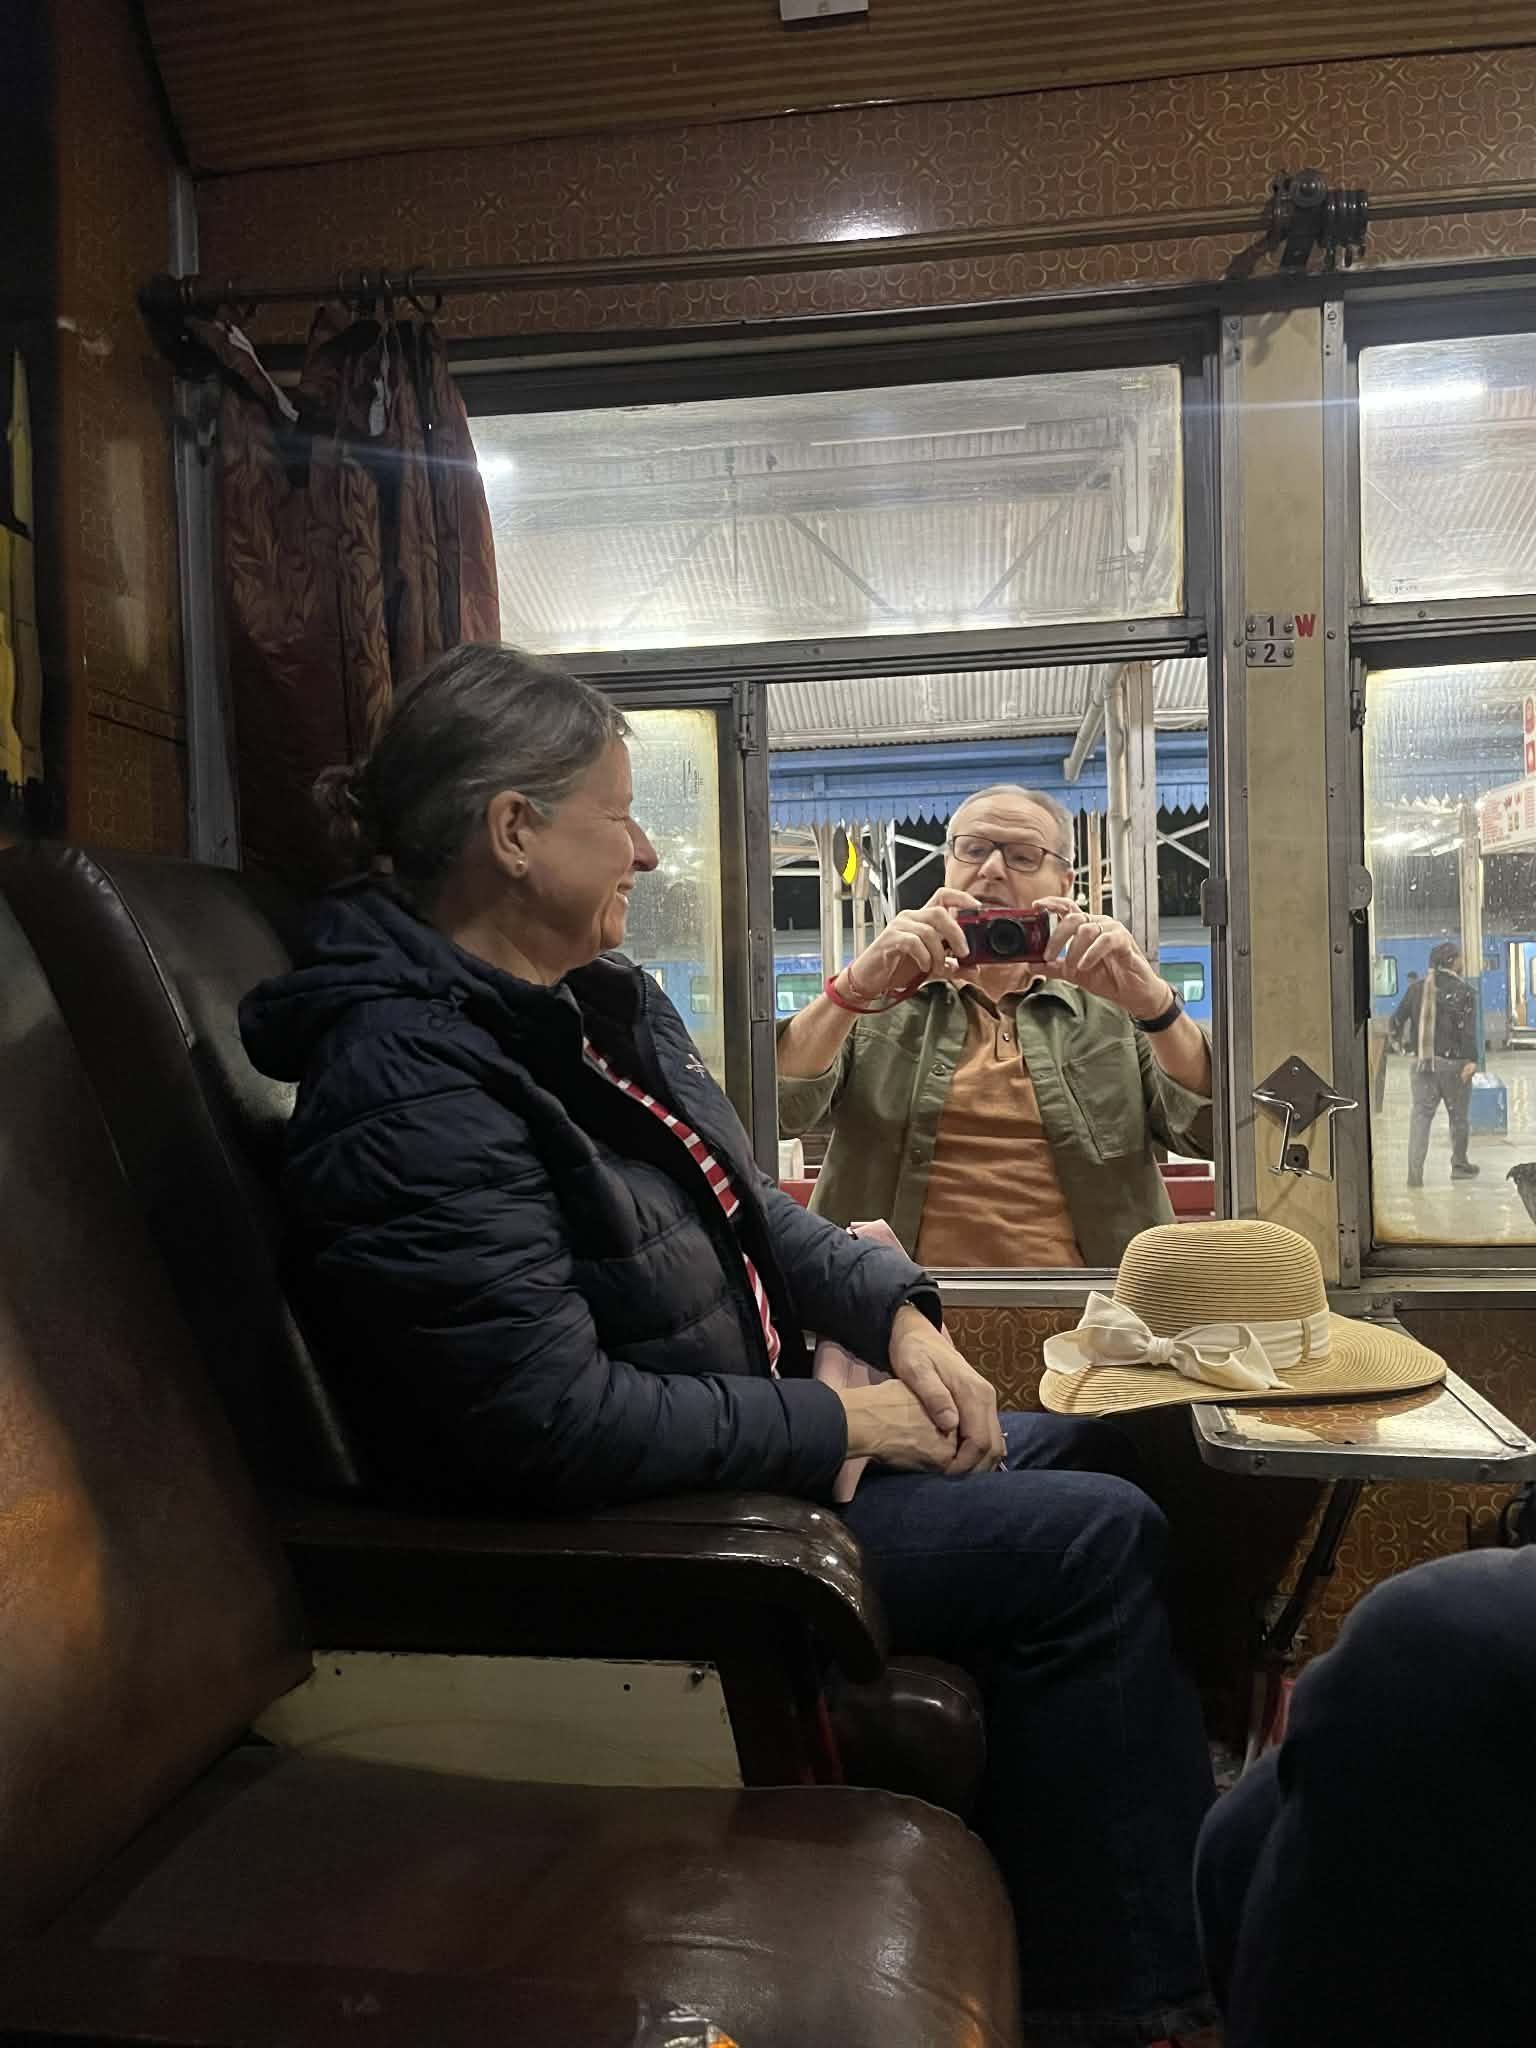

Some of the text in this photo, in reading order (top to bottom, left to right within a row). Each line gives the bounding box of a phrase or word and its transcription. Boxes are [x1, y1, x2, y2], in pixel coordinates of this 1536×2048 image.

[1266, 615, 1275, 637] 1
[1295, 613, 1316, 637] W
[1263, 642, 1277, 663] 2
